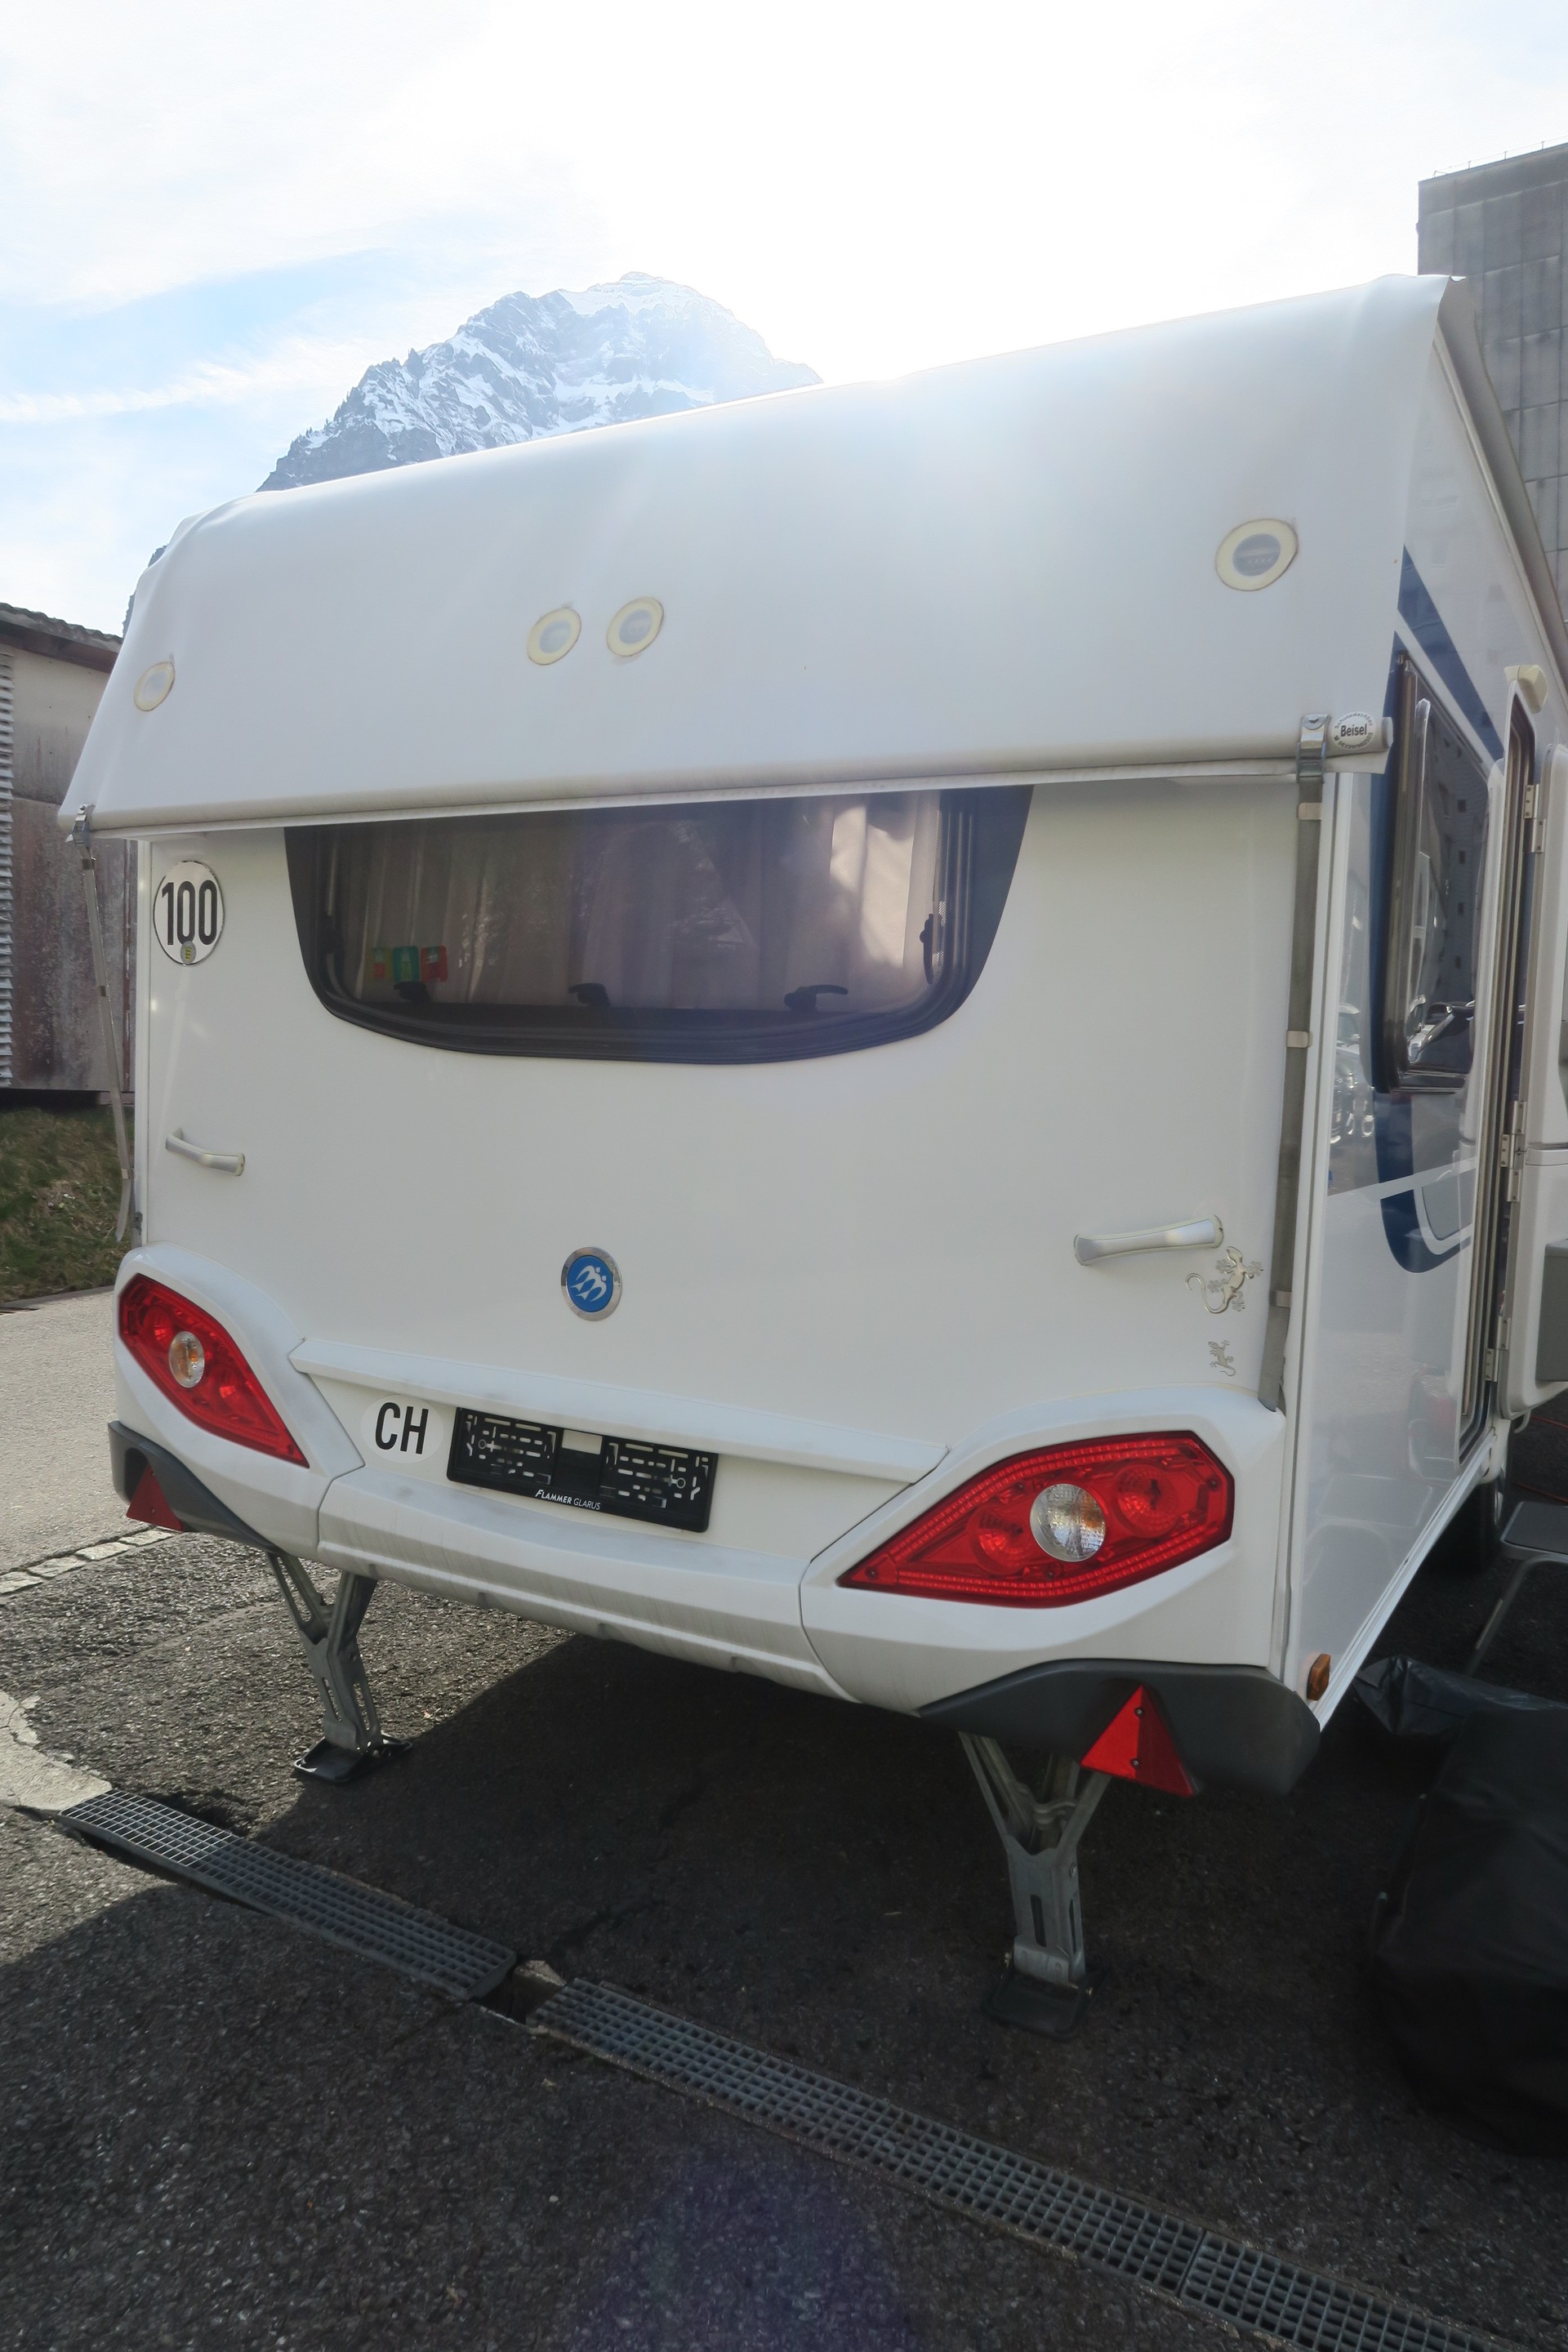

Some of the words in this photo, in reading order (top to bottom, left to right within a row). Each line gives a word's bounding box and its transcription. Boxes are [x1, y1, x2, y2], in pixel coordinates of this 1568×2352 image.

[1340, 723, 1368, 737] Beisel
[162, 880, 218, 946] 100
[374, 1401, 429, 1455] CH
[535, 1489, 572, 1504] FLAMMER
[573, 1498, 601, 1511] GLARUS
